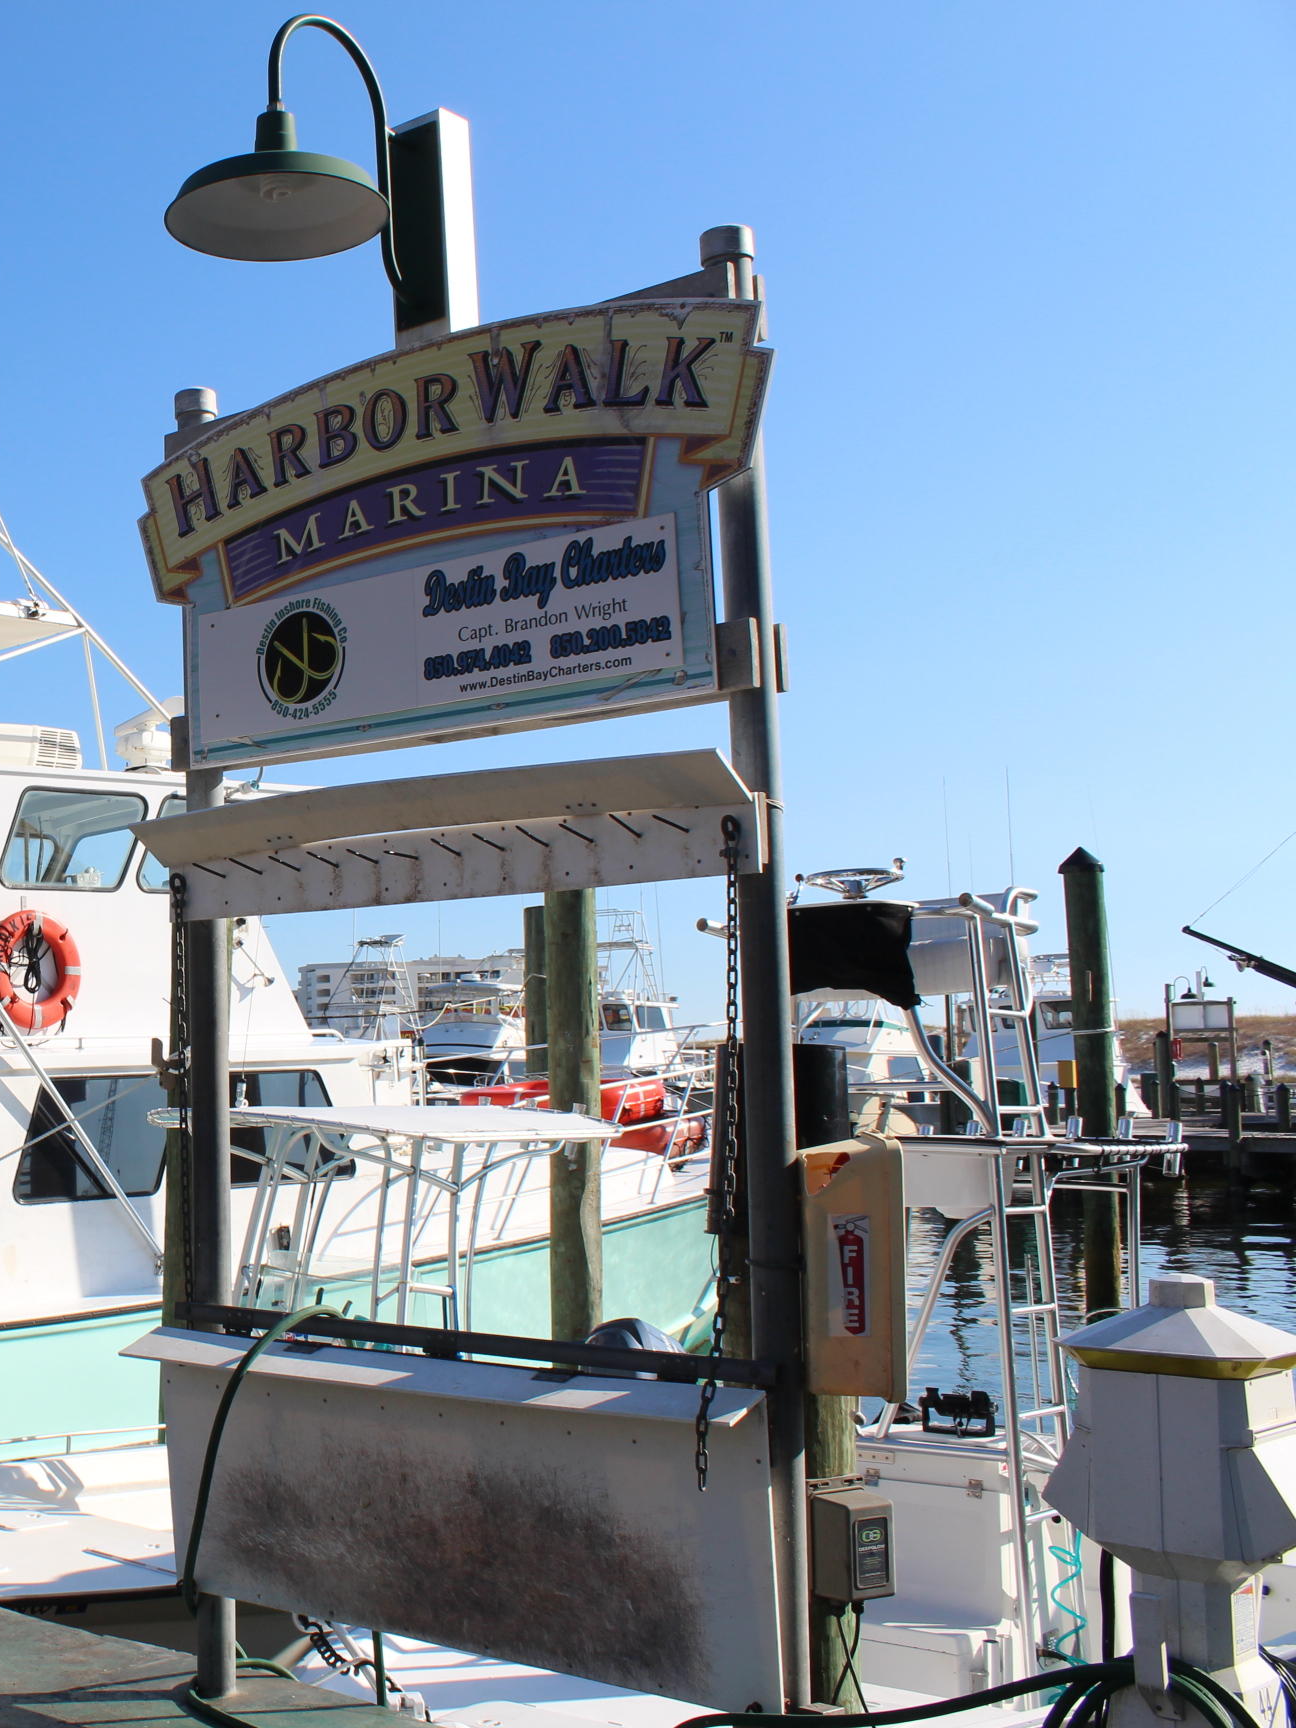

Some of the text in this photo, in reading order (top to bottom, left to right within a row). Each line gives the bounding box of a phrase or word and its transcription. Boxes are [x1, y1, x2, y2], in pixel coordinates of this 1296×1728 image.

[272, 455, 588, 567] MARINA
[422, 535, 667, 618] Destin Bay Charters
[256, 619, 277, 656] Destin
[275, 598, 311, 622] Inshore
[312, 597, 343, 631] Fishing
[423, 614, 672, 681] 850.974.4042 850.200.5842
[458, 597, 629, 644] Capt. Brandon Wright
[270, 689, 337, 720] 850-424-5555
[459, 656, 633, 693] www.DestinBayCharters.com
[843, 1245, 860, 1328] FIRE
